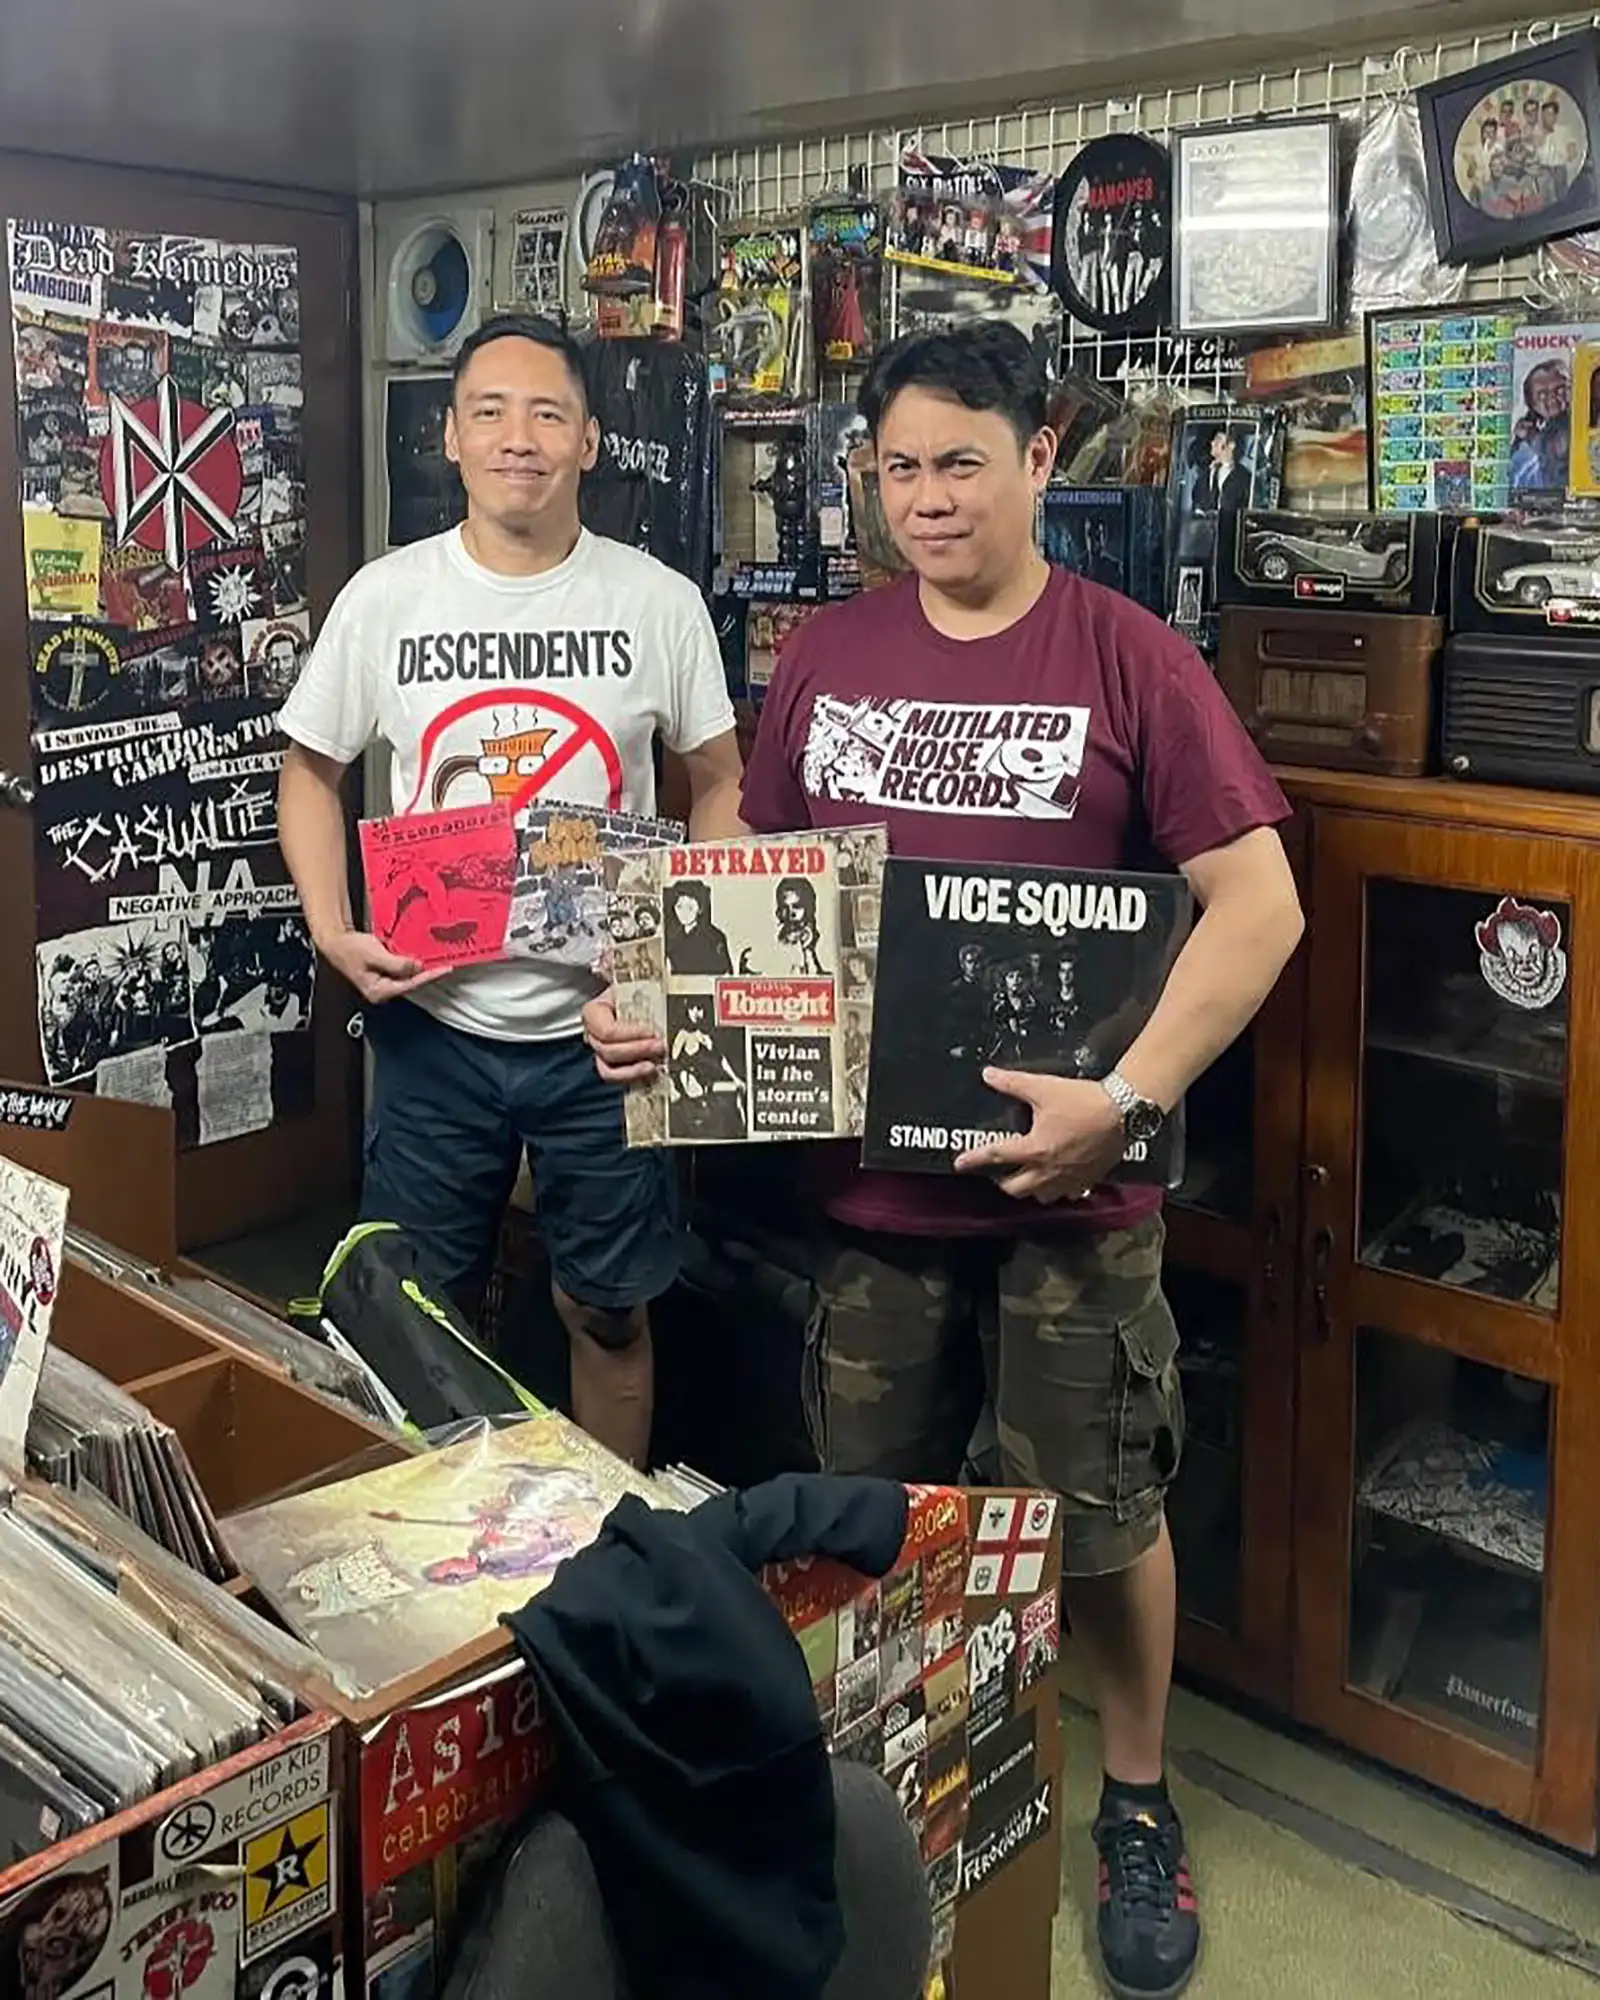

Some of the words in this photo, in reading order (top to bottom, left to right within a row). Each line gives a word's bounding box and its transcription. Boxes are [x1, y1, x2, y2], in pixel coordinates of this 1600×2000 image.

[16, 231, 115, 276] Dead
[131, 240, 292, 290] Kennedys
[13, 269, 93, 306] CAMBODIA
[1513, 334, 1583, 350] CHUCKY
[397, 630, 633, 686] DESCENDENTS
[902, 707, 1071, 742] MUTILATED
[40, 722, 216, 785] DESTRUCTION
[889, 737, 983, 773] NOISE
[879, 767, 1021, 809] RECORDS
[669, 846, 826, 877] BETRAYED
[116, 893, 202, 914] NEGATIVE
[212, 888, 298, 907] APPROACH
[924, 874, 1012, 924] VICE
[1015, 880, 1147, 937] SQUAD
[722, 988, 830, 1021] Tonight
[755, 1043, 821, 1062] Vivian
[757, 1068, 777, 1081] in
[783, 1066, 814, 1083] the
[756, 1088, 829, 1104] storm's
[757, 1109, 820, 1125] center
[889, 1124, 948, 1150] STAND
[384, 1674, 543, 1815] Asia
[249, 1765, 282, 1794] HIP
[288, 1742, 322, 1776] KID
[220, 1770, 321, 1836] RECORDS
[1034, 1784, 1050, 1826] X
[274, 1852, 300, 1888] R
